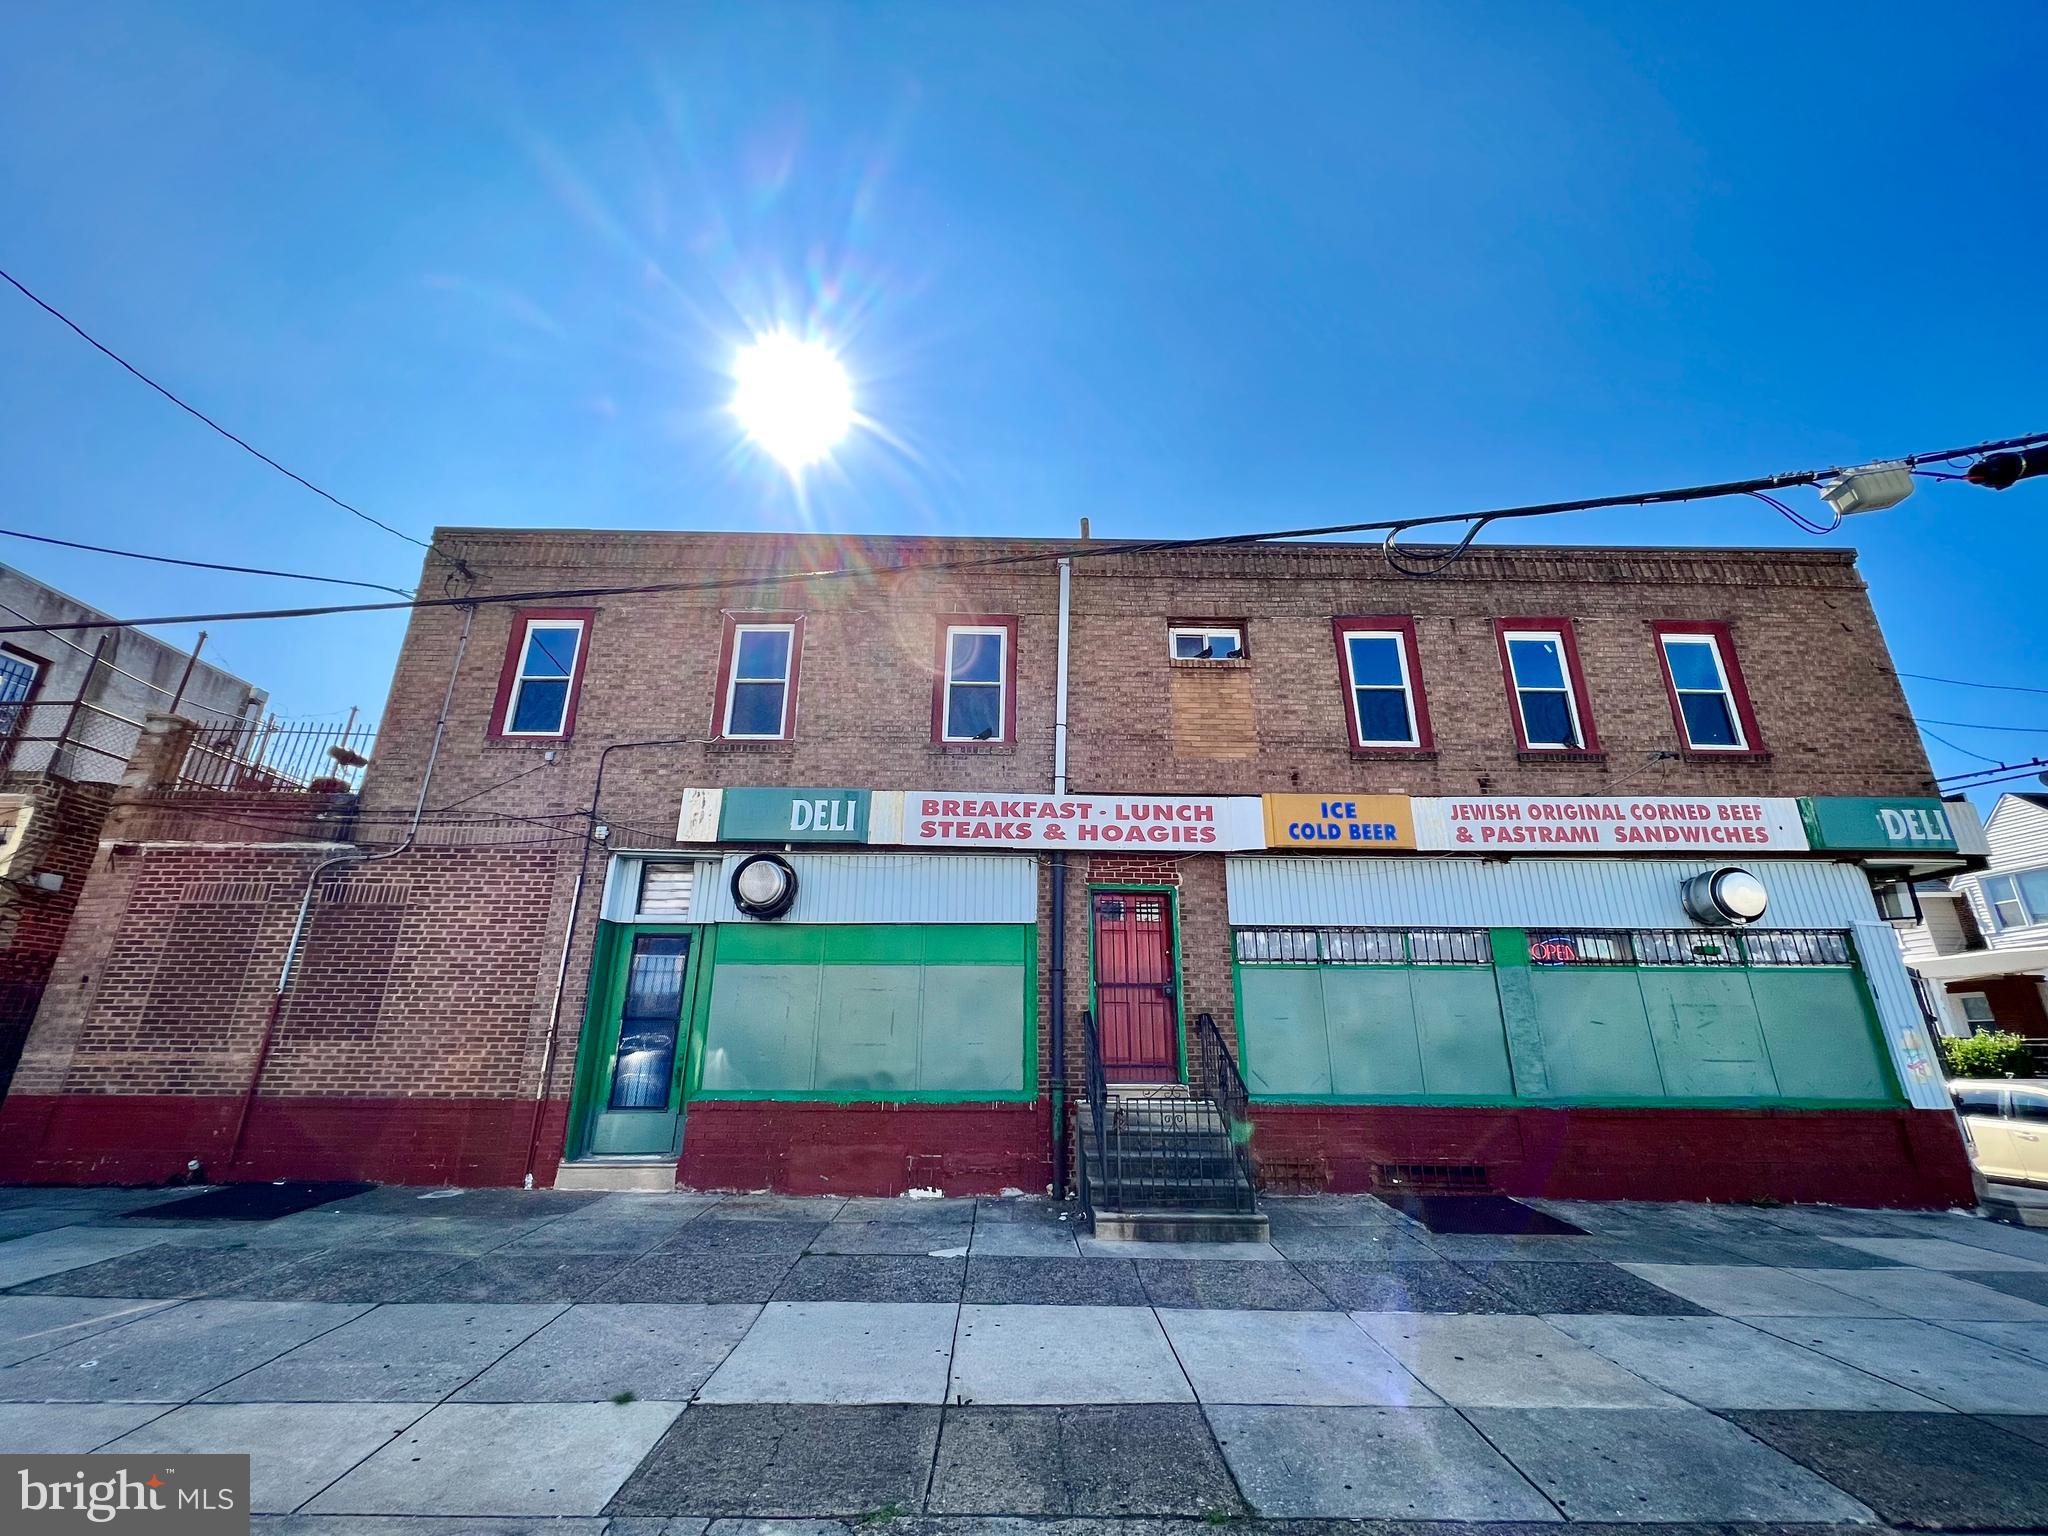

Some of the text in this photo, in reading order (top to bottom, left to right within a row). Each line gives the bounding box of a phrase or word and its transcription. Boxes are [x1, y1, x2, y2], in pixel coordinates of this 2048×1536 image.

[789, 799, 857, 832] DELI
[921, 799, 1093, 820] BREAKFAST
[1115, 803, 1214, 822] LUNCH
[1321, 802, 1358, 819] ICE
[1450, 803, 1763, 822] JEWISH ORIGINAL CORNED BEEF
[919, 821, 1217, 843] STEAKS & HOAGIES
[1288, 822, 1397, 841] COLD BEER
[1879, 808, 1952, 840] DELI
[1455, 825, 1770, 843] & PASTRAMI SANDWICHES
[1531, 943, 1579, 961] OPEN
